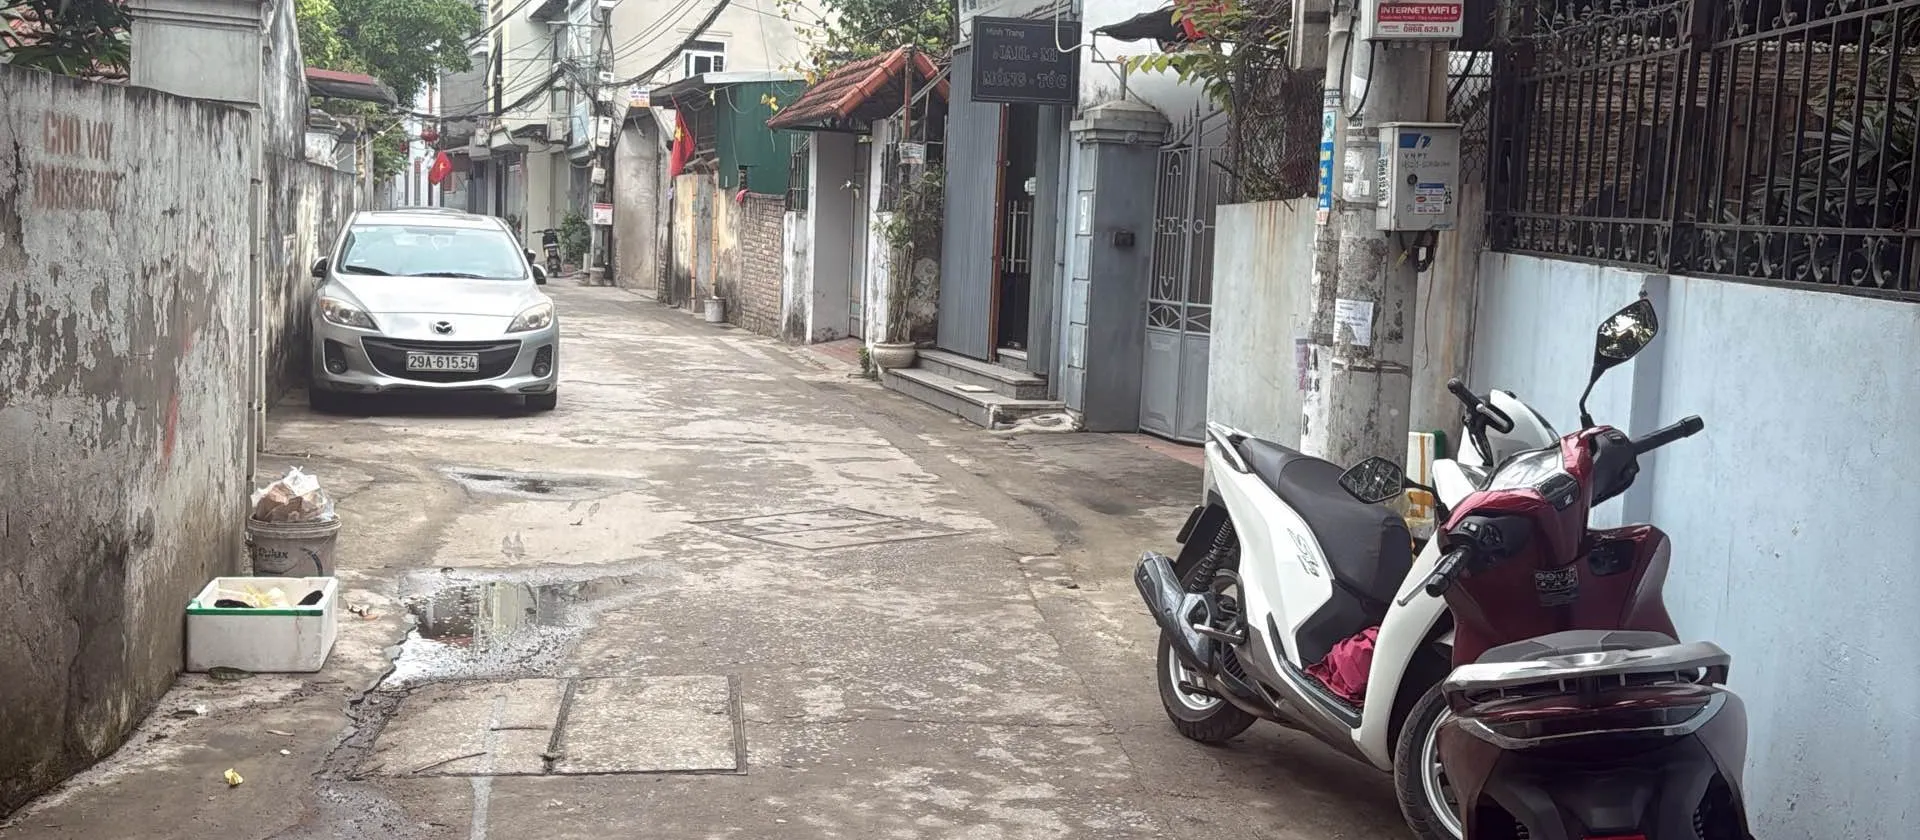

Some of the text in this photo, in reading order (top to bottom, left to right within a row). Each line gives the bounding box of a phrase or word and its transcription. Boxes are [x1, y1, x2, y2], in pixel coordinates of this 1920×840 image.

[1380, 6, 1426, 14] INTERNET
[1427, 6, 1450, 14] WIFI
[43, 110, 114, 161] CHO VAY
[1403, 152, 1428, 160] VNPT
